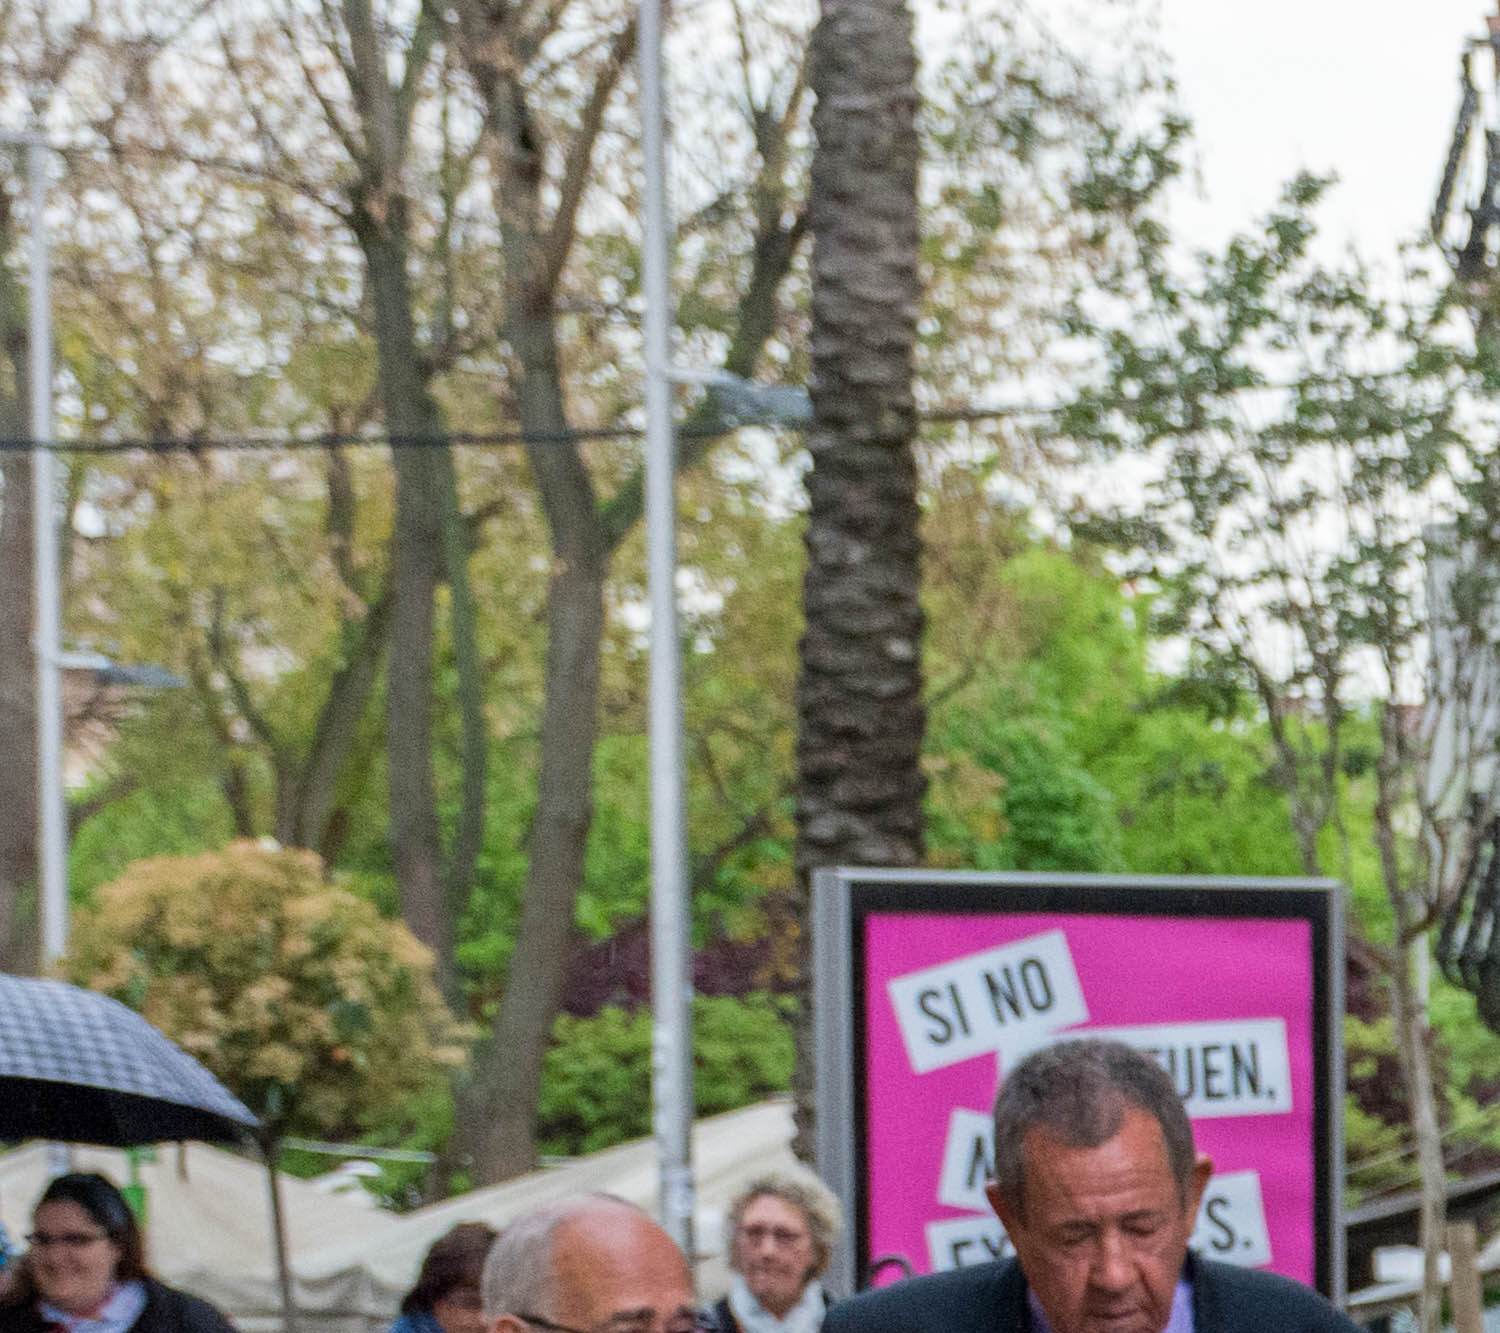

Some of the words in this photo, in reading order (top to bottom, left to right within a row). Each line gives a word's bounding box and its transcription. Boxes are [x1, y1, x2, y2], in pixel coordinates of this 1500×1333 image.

[917, 983, 971, 1044] SI
[982, 955, 1054, 1025] NO
[1148, 1040, 1276, 1102] UEN.
